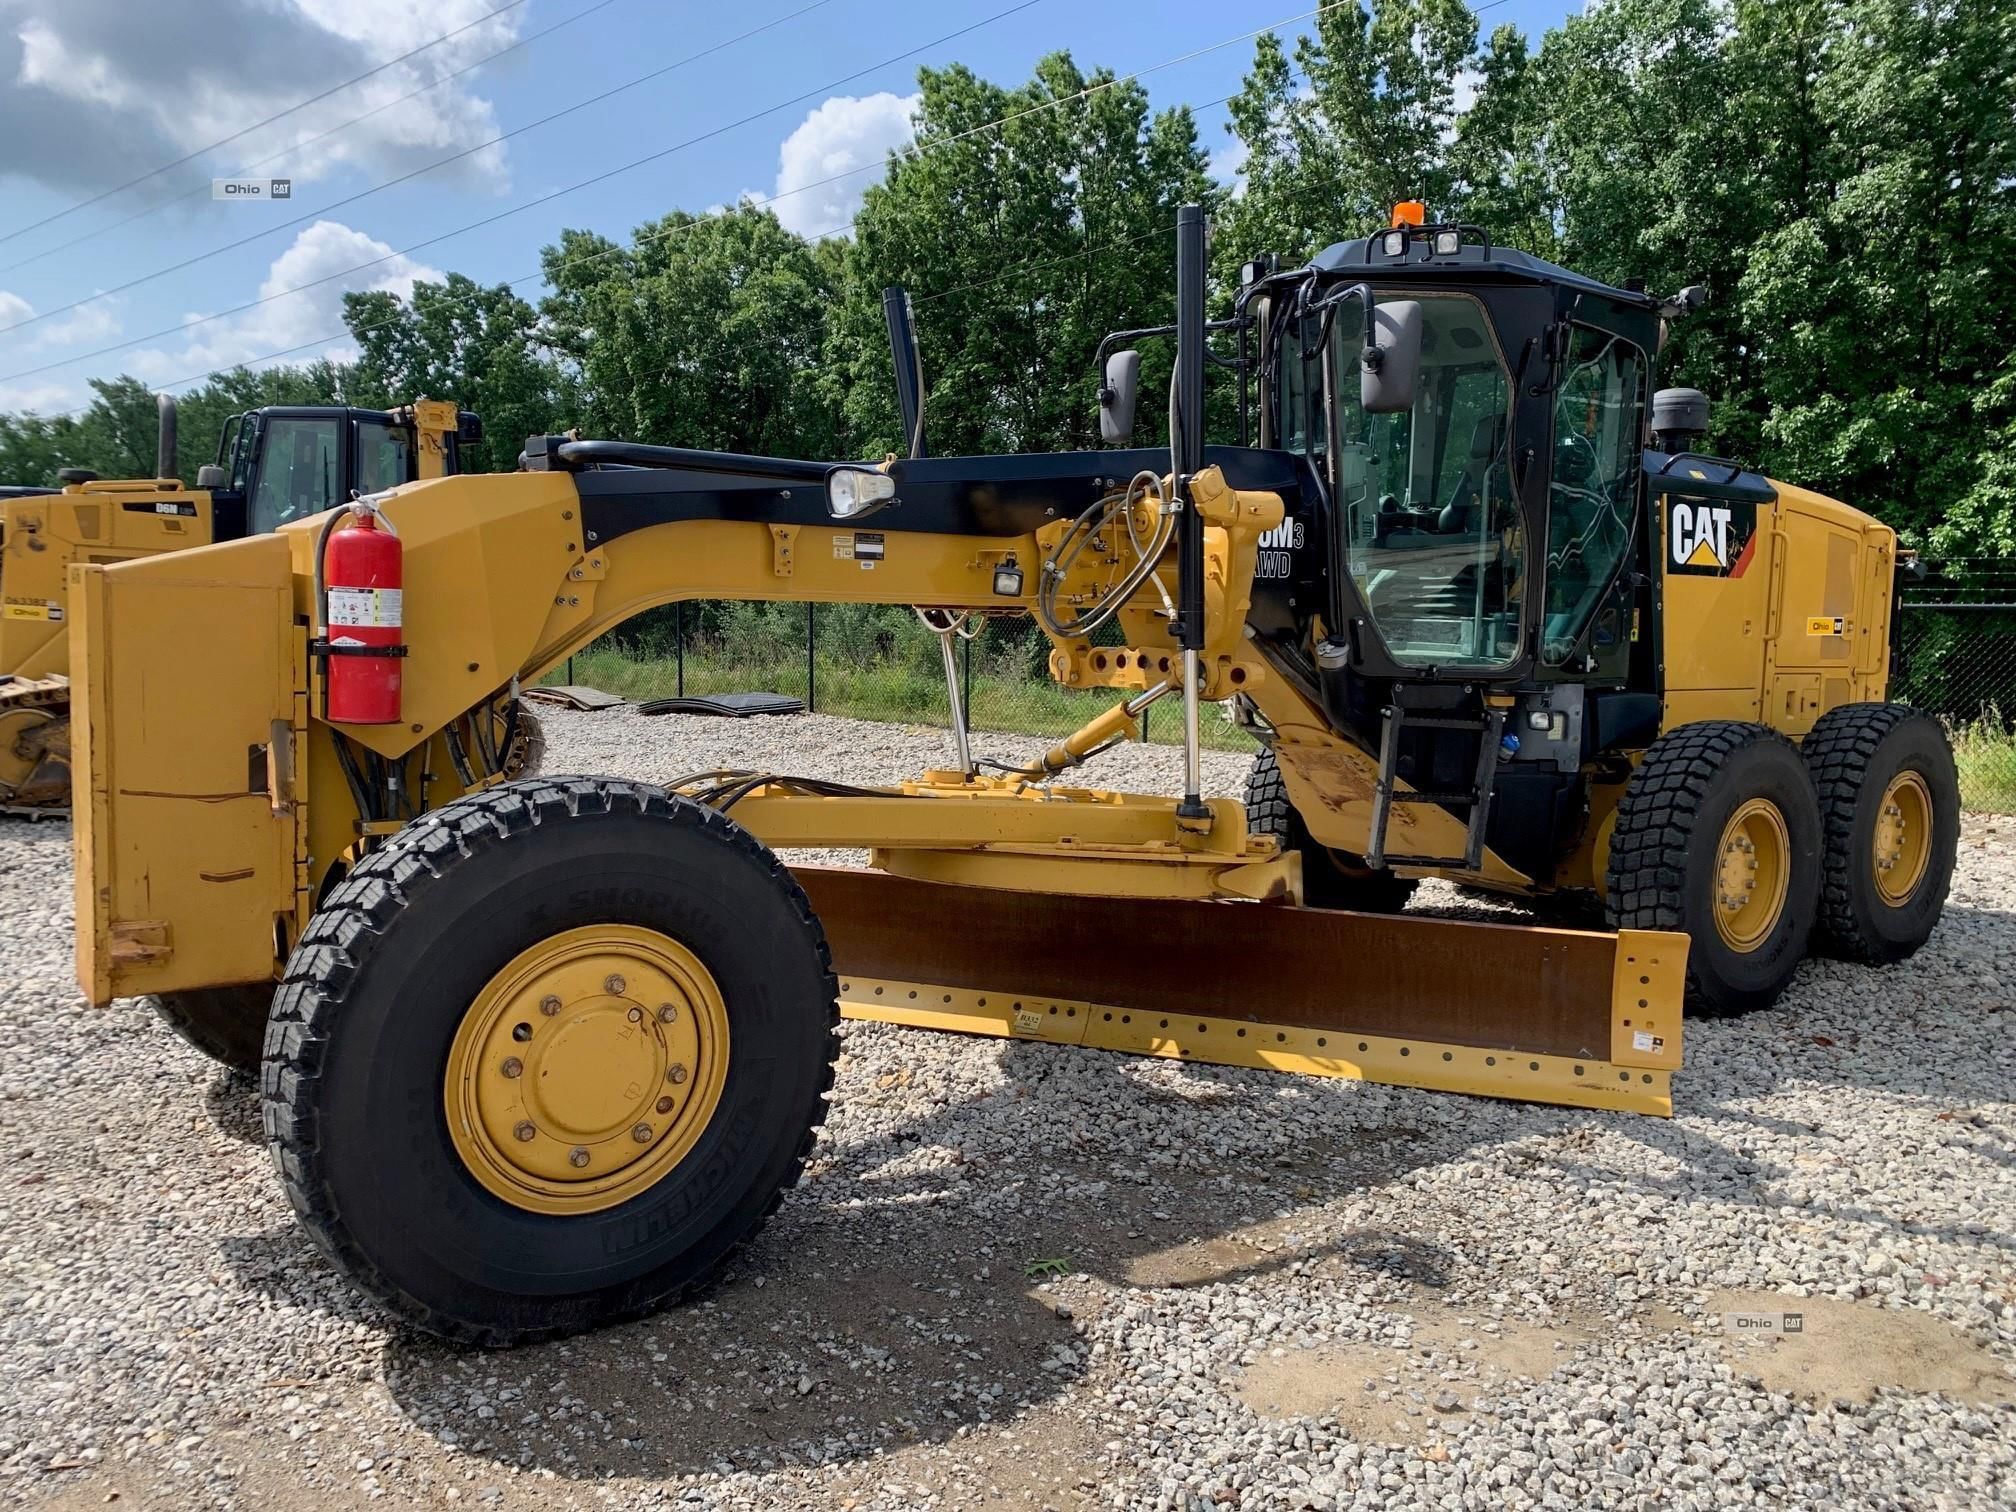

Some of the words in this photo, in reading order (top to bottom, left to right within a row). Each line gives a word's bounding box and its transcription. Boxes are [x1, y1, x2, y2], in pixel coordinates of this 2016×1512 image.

[155, 502, 178, 514] D6N
[1672, 503, 1731, 567] CAT
[1812, 622, 1830, 631] Ohio
